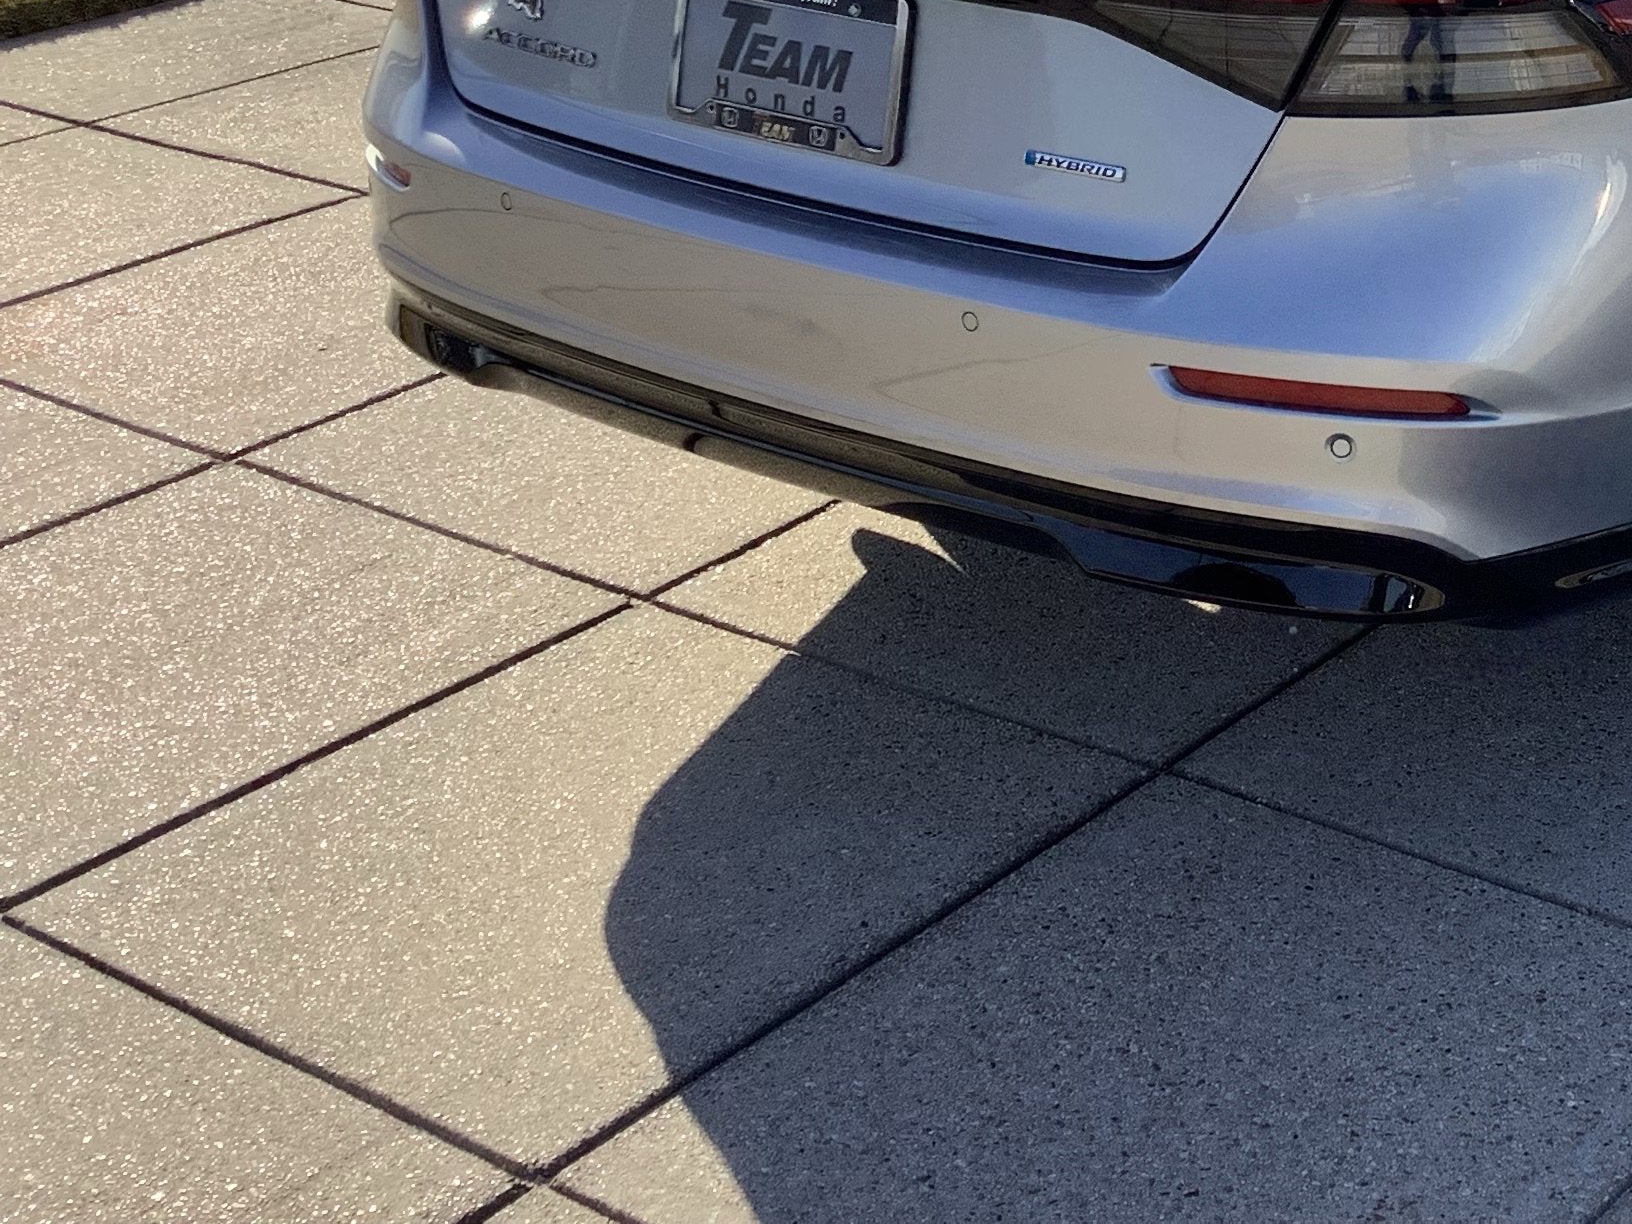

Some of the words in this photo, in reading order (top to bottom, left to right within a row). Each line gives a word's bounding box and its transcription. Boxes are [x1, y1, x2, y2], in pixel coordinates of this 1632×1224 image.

[484, 27, 598, 68] ACCORD
[716, 1, 853, 93] TEAM
[715, 75, 847, 123] Honda
[1038, 155, 1117, 178] HYBRID
